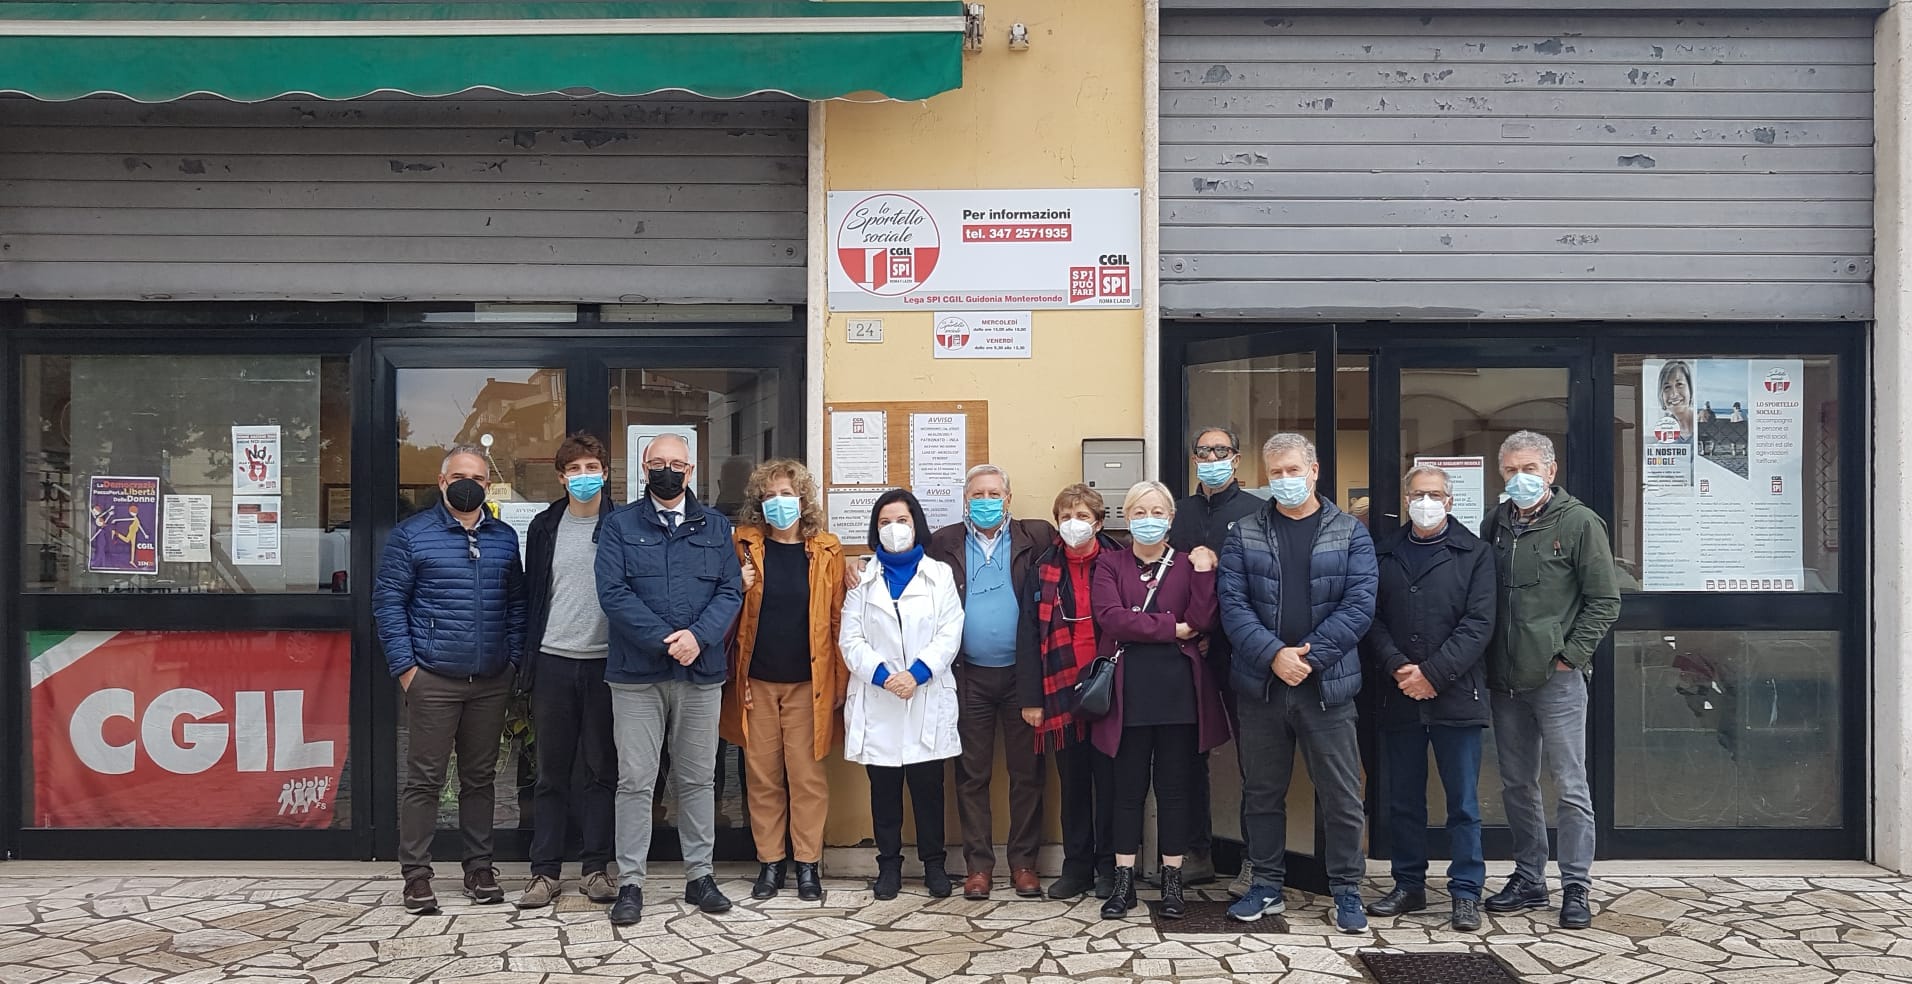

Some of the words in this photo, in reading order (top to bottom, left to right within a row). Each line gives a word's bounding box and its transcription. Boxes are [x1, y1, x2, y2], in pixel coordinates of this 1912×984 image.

[878, 202, 890, 214] lo
[962, 209, 985, 220] Per
[989, 208, 1071, 220] informazioni
[846, 207, 926, 235] Sportello
[862, 226, 913, 243] sociale
[965, 228, 986, 239] tel.
[989, 228, 1012, 239] 347
[1015, 228, 1068, 239] 2571935
[889, 247, 912, 256] CGIL
[1098, 254, 1130, 266] CGIL
[892, 263, 910, 277] SPI
[1072, 270, 1094, 280] SPI
[1102, 276, 1127, 294] SPI
[1072, 288, 1094, 296] FARE
[903, 296, 925, 304] Lega
[943, 295, 964, 303] CGIL
[965, 295, 1003, 303] Guidonia
[1004, 295, 1063, 303] Monterotondo
[856, 323, 874, 337] 24
[1647, 448, 1653, 456] IL
[1655, 448, 1687, 456] NOSTRO
[1647, 457, 1676, 466] GOOGLE
[69, 687, 334, 775] CGIL
